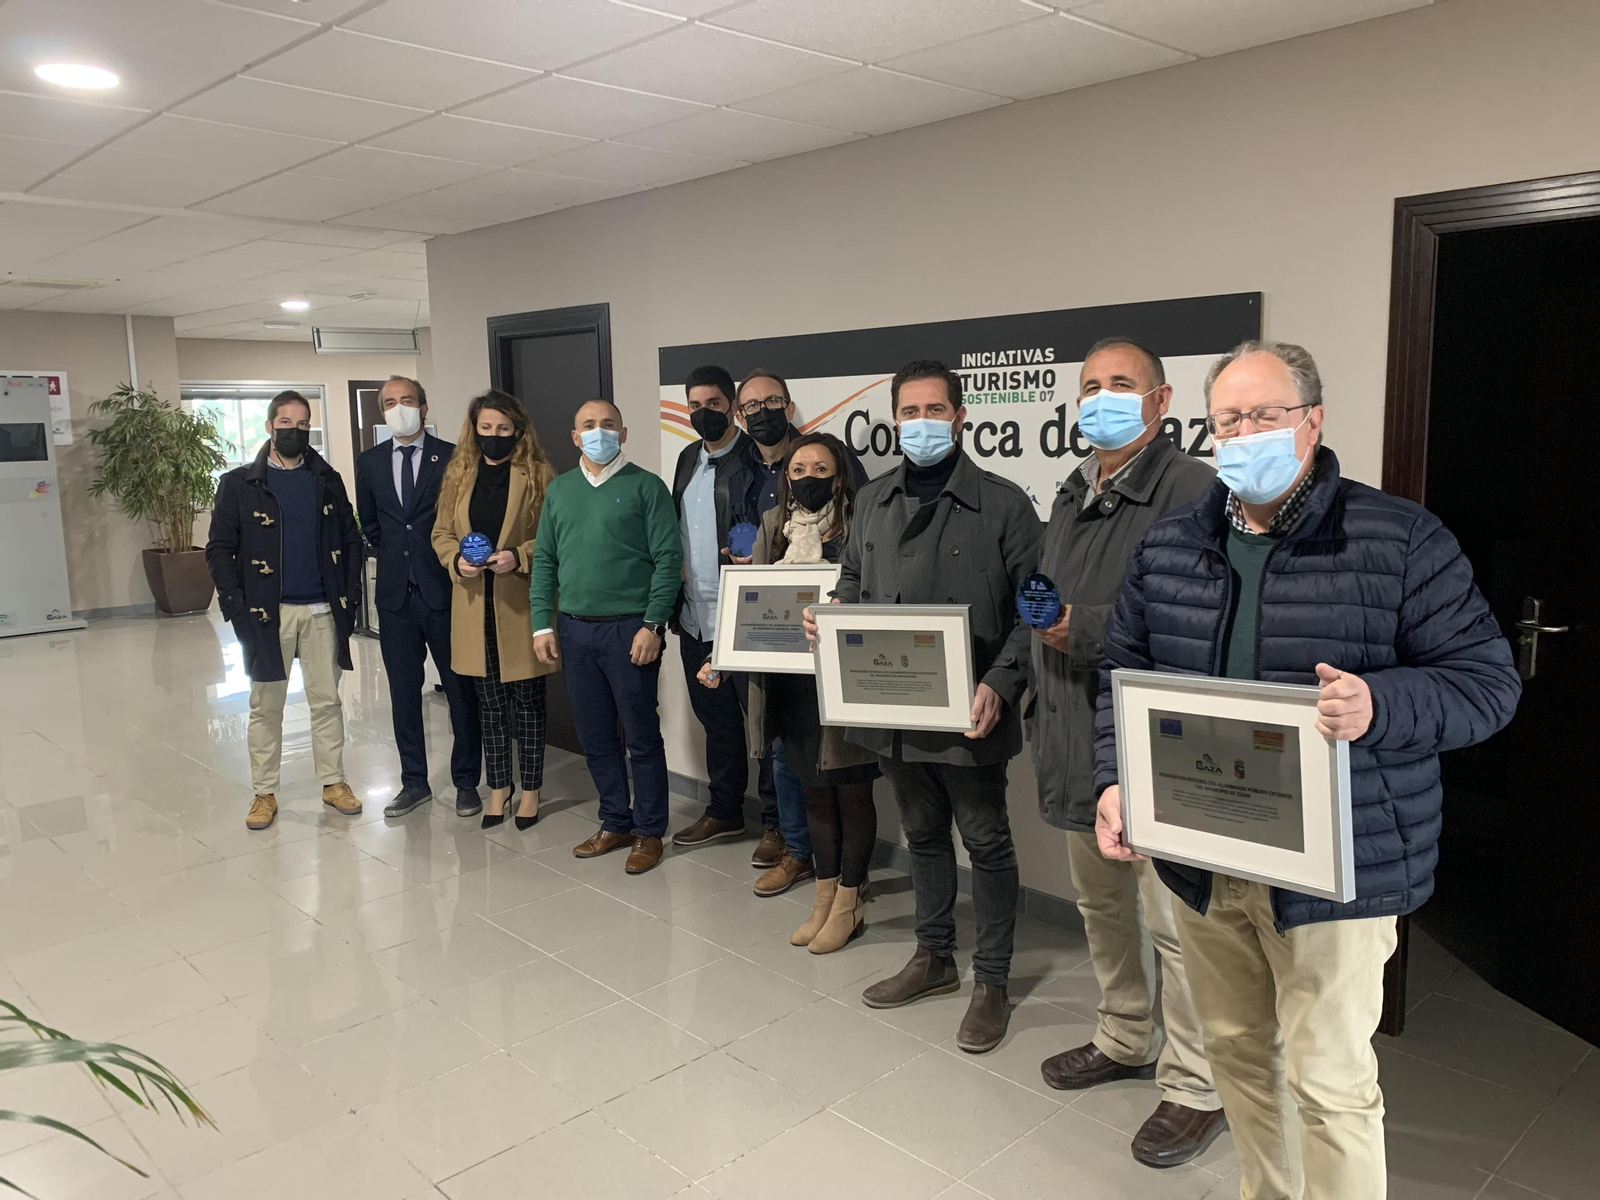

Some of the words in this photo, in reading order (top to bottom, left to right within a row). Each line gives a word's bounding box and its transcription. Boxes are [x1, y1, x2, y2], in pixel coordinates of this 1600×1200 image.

[961, 347, 1055, 368] INICIATIVAS
[960, 369, 1056, 392] TURISMO
[961, 391, 1036, 405] SOSTENIBLE
[1039, 390, 1055, 402] 07
[845, 408, 1023, 458] Corca
[1195, 760, 1223, 774] BAZA
